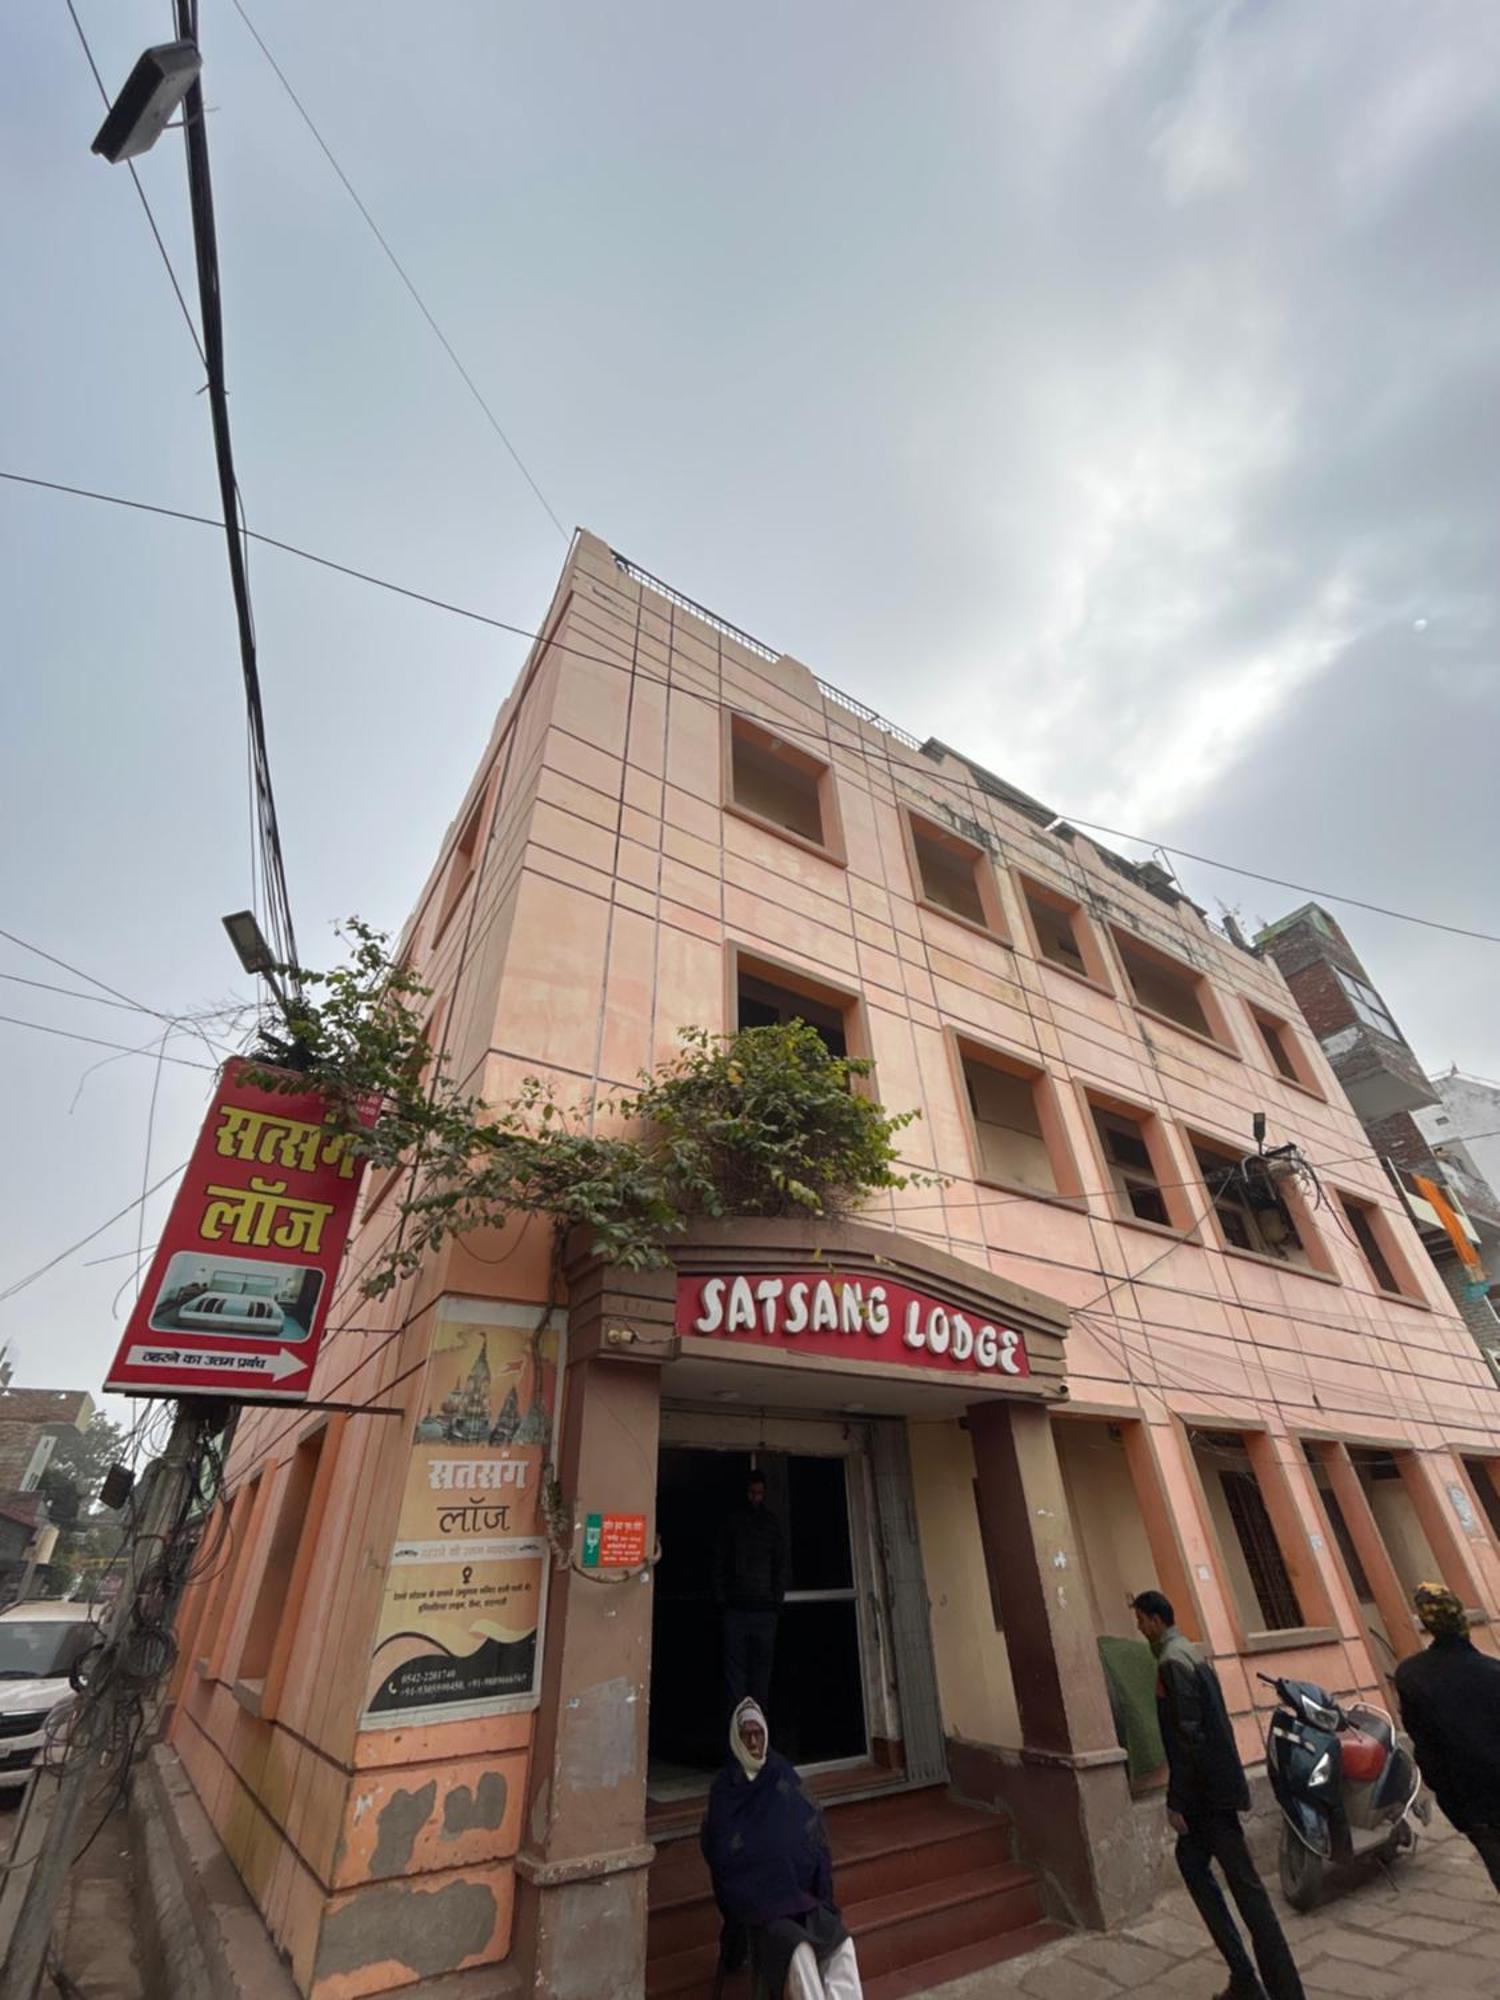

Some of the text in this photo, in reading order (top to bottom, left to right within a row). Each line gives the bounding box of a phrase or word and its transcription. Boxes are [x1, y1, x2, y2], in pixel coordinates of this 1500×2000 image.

[200, 1177, 334, 1253] लॉज
[694, 1275, 1021, 1374] SATSANG LODGE
[183, 1354, 201, 1366] का
[427, 1451, 529, 1489] सतसंग
[436, 1497, 511, 1533] लॉज
